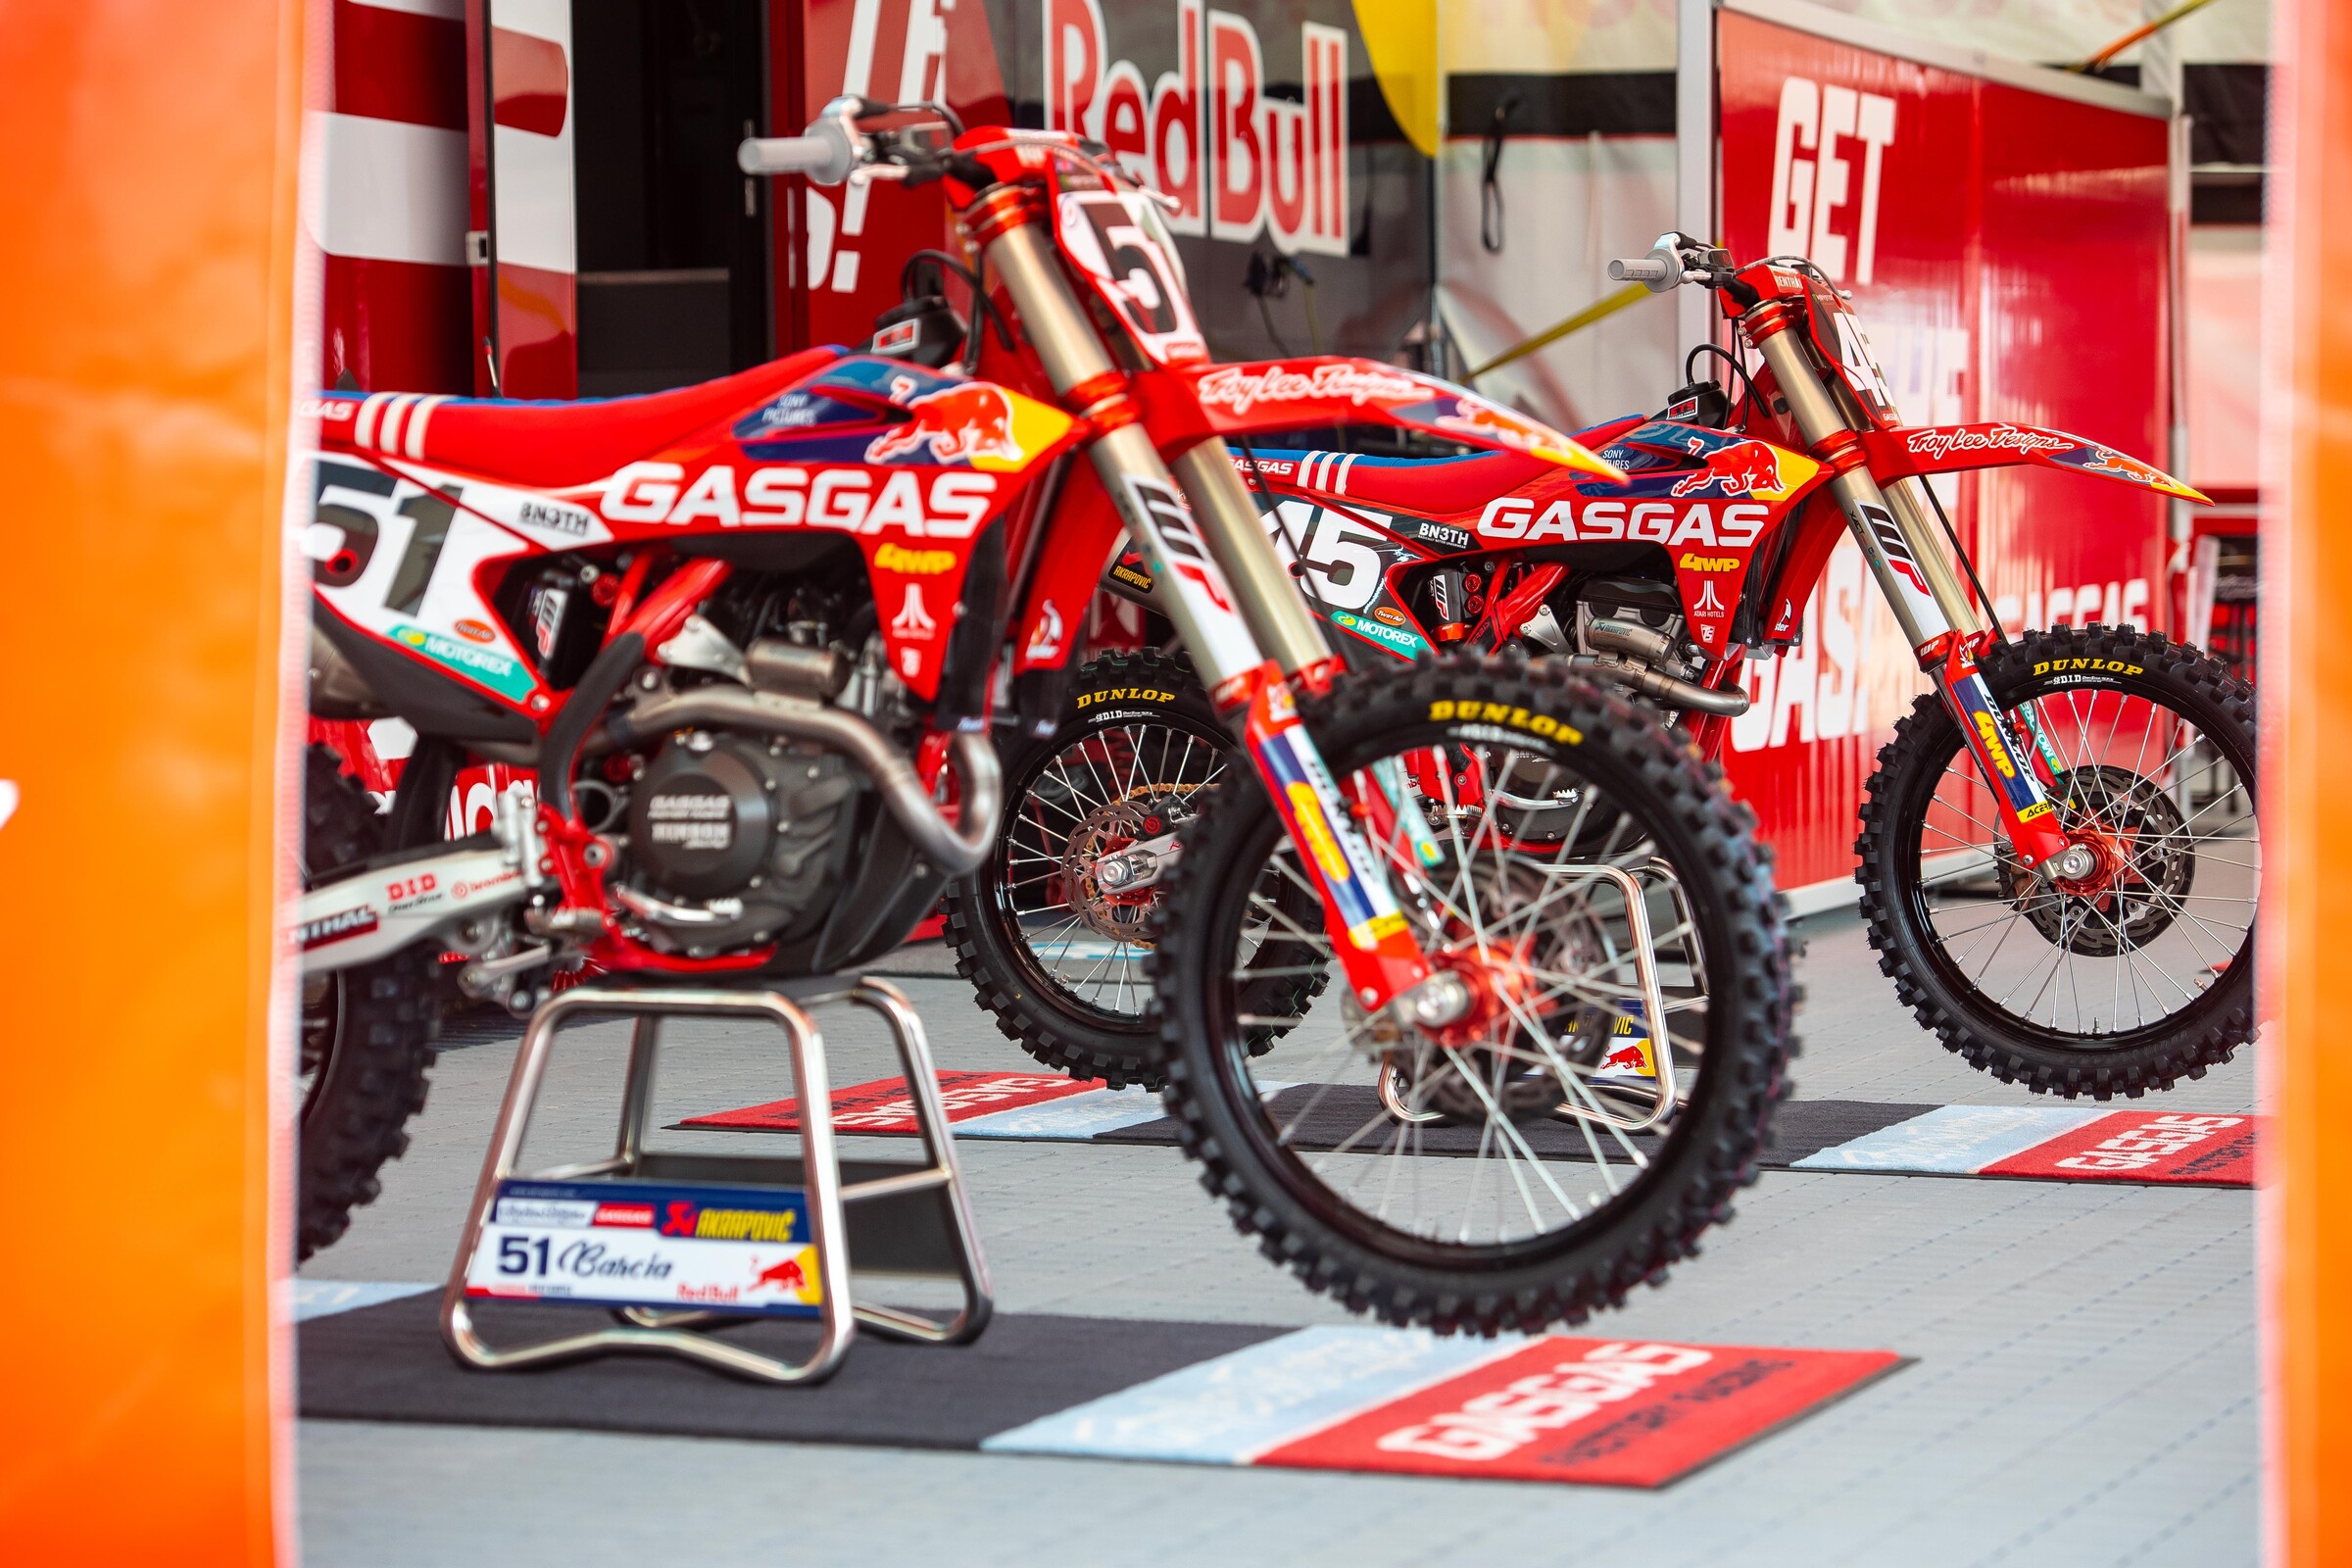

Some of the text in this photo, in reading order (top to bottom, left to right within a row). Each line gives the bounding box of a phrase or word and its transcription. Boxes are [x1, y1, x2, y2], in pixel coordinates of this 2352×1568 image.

[1044, 0, 1206, 237] Red
[1207, 10, 1348, 258] Bull
[1769, 77, 1895, 283] GET
[1199, 368, 1259, 415] Troy
[1255, 366, 1311, 401] Lee
[1670, 399, 1695, 416] ETS
[1603, 450, 1624, 459] SONY
[1907, 426, 2075, 460] Troy Lee Designs
[600, 461, 997, 538] GASGAS
[1418, 522, 1470, 546] BN3TH
[1477, 497, 1770, 547] GASGAS
[1355, 619, 1418, 649] MOTOREX
[1377, 610, 1404, 622] Twin Air
[1920, 640, 1940, 657] WP
[2033, 658, 2144, 676] DUNLOP
[1076, 688, 1176, 710] DUNLOP
[1429, 699, 1585, 747] DUNLOP
[2020, 700, 2055, 760] MOTORE
[2054, 1115, 2245, 1171] GASGAS
[500, 1236, 672, 1278] 51 Barcia
[677, 1284, 739, 1302] Red Bull
[1376, 1343, 1716, 1461] GASGAS
